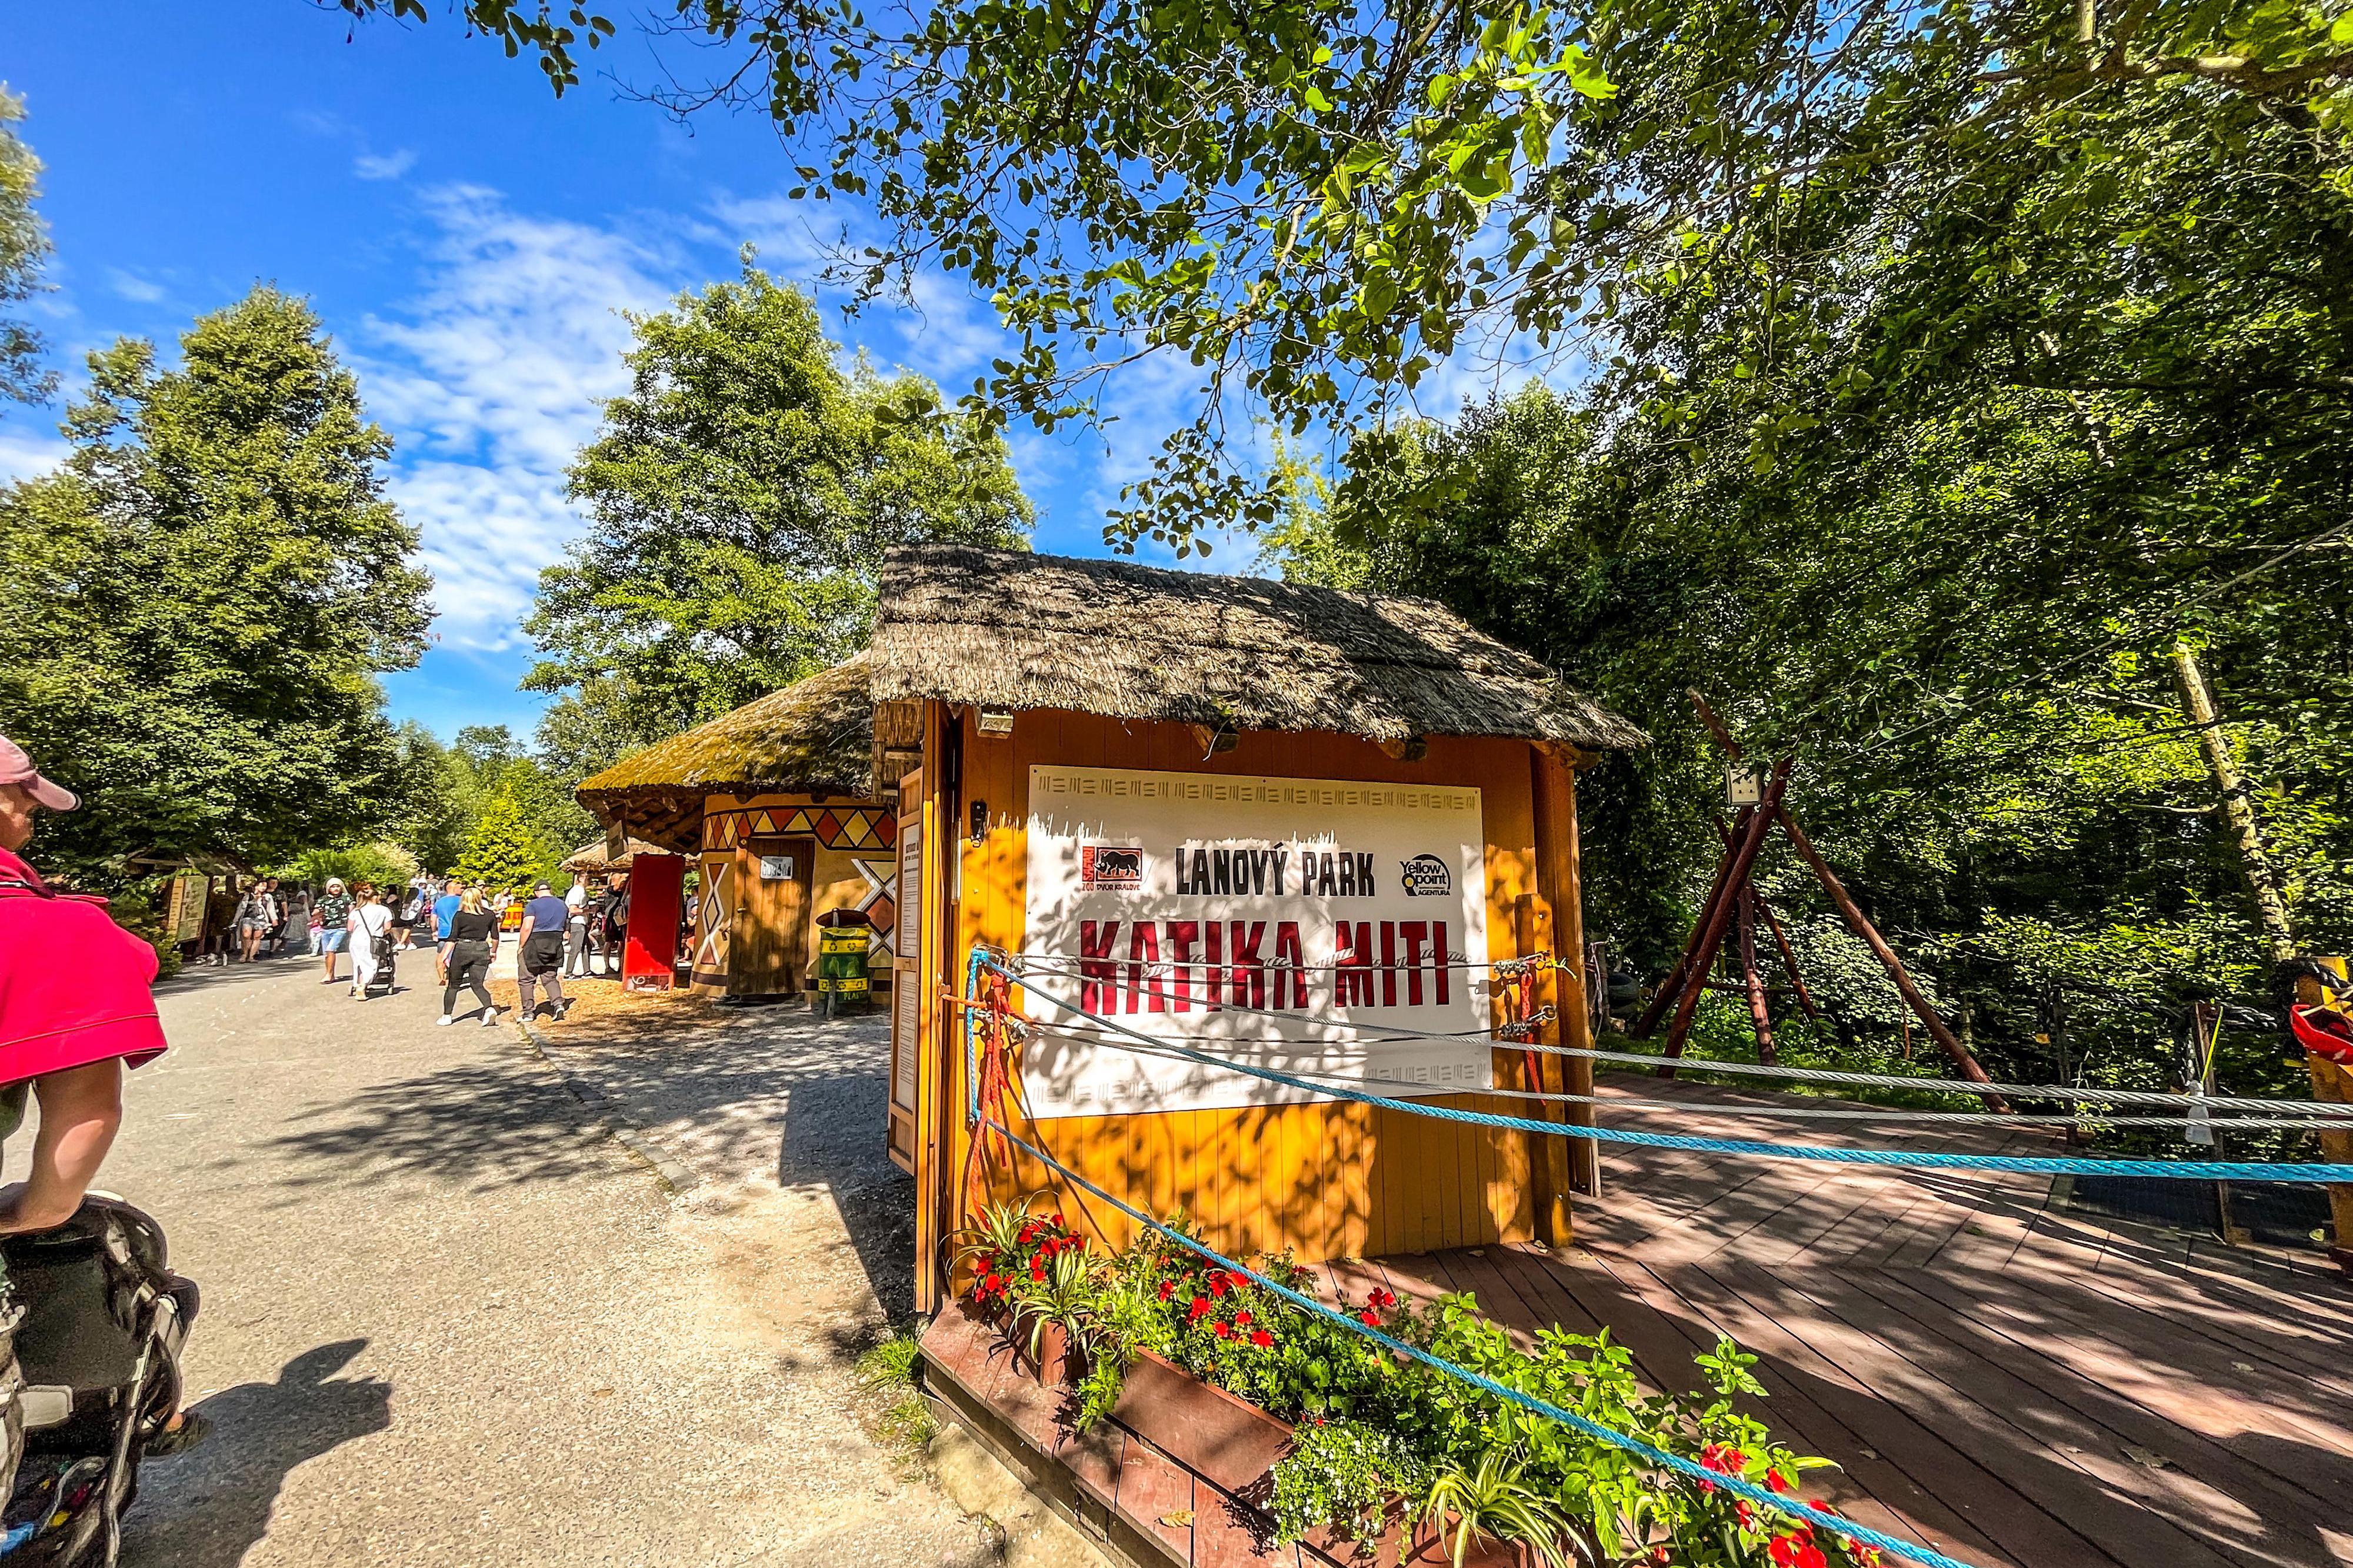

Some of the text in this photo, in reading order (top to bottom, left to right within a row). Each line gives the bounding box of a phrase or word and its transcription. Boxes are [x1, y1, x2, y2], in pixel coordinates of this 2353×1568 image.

[1083, 847, 1094, 880] SAFARI
[1176, 842, 1375, 897] LANOVÝ PARK
[1399, 861, 1441, 874] Yellow
[1082, 883, 1094, 891] ZOO
[1415, 873, 1447, 887] point
[1080, 920, 1449, 1015] KATIKA MITI
